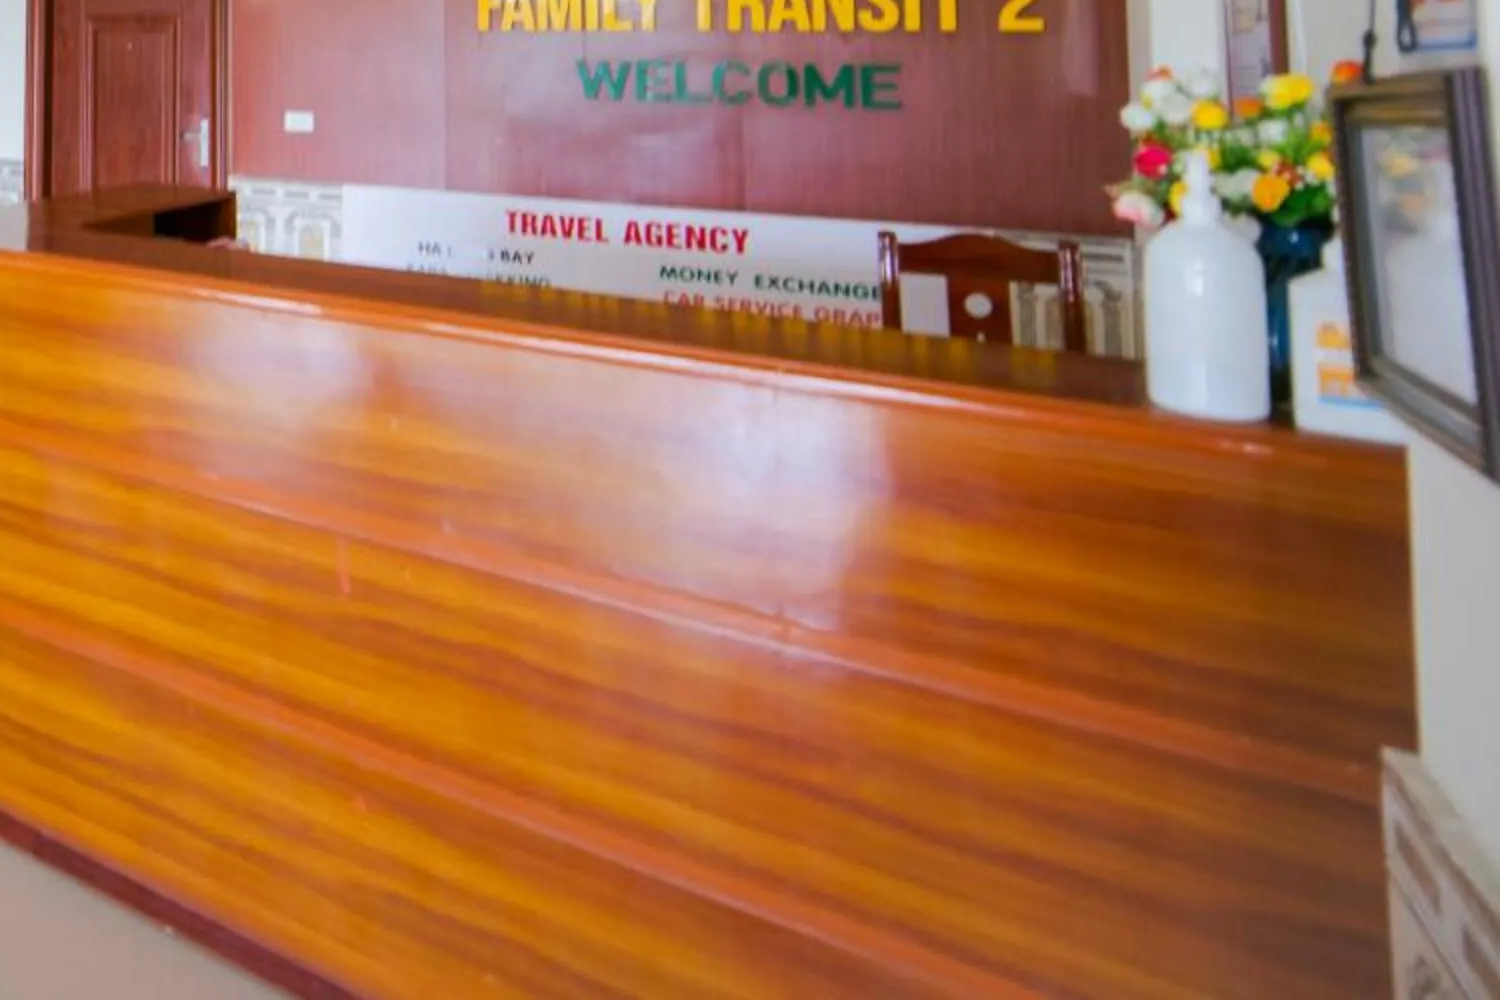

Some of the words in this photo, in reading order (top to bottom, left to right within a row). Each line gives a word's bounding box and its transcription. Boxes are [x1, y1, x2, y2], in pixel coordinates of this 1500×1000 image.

[575, 57, 903, 110] WELCOME
[506, 210, 609, 244] TRAVEL
[624, 220, 749, 255] AGENCY
[500, 249, 534, 265] BAY
[659, 265, 738, 286] MONEY
[663, 290, 705, 309] CAR
[715, 295, 803, 319] SERVICE
